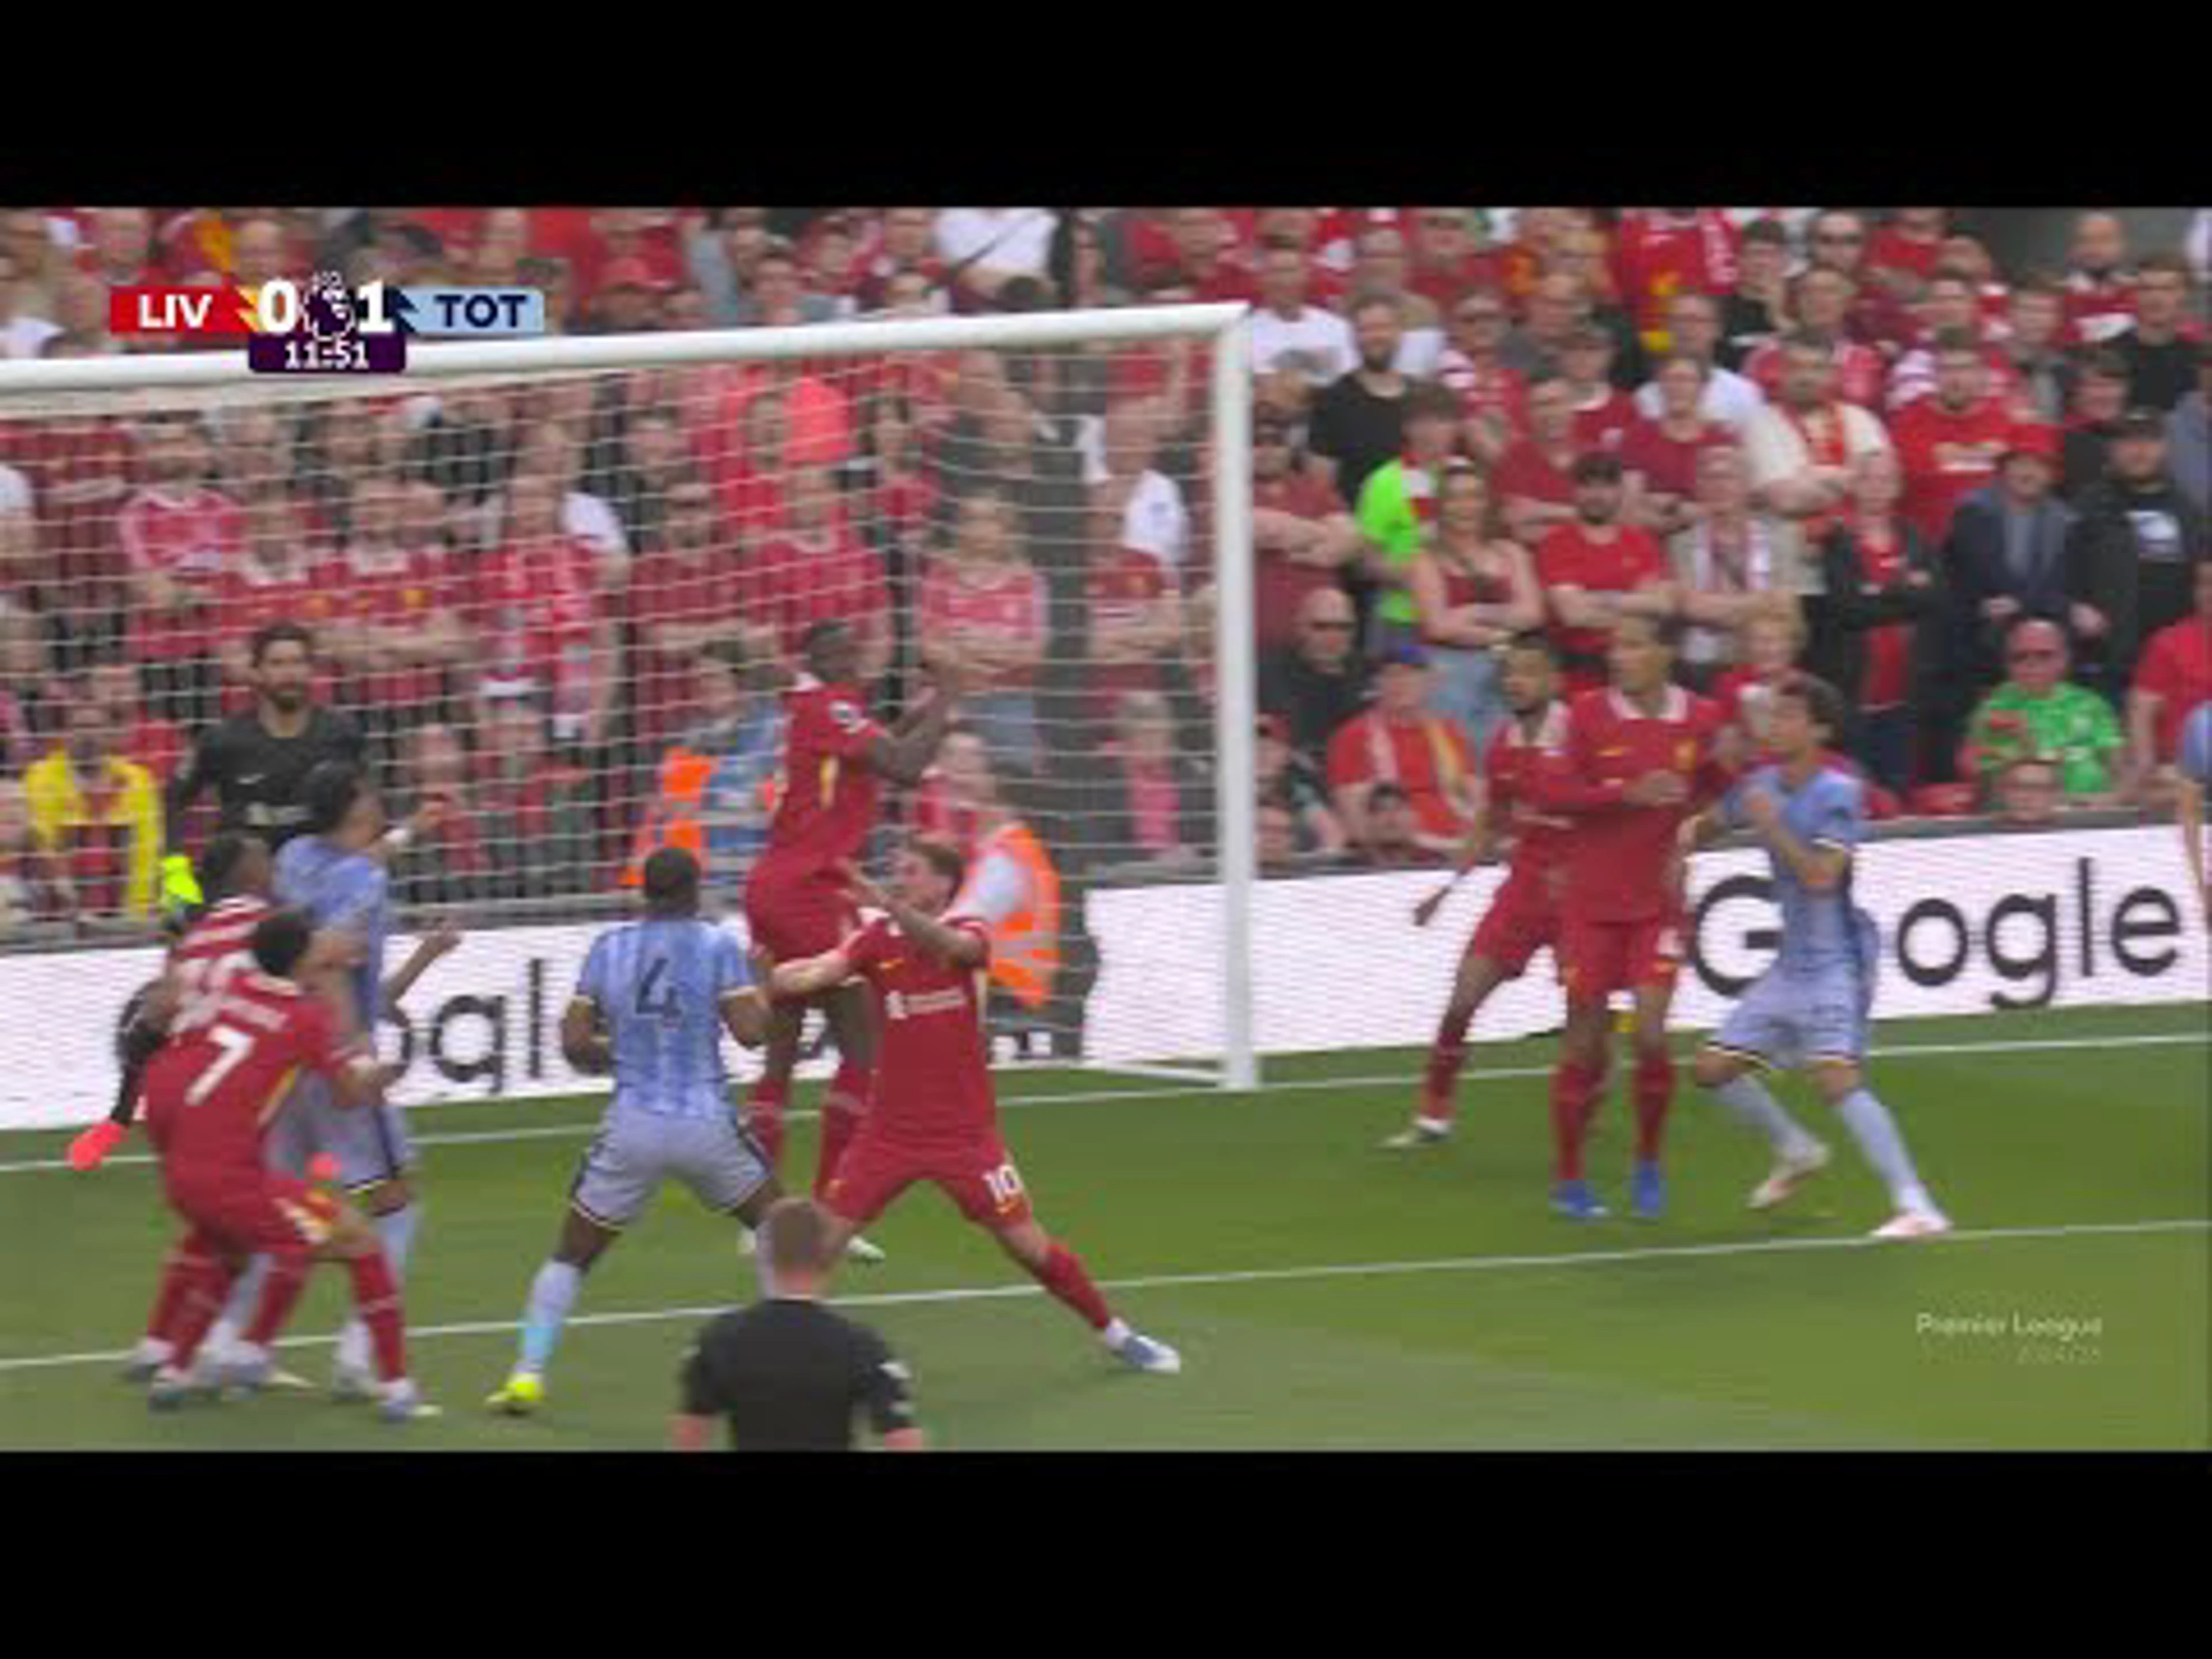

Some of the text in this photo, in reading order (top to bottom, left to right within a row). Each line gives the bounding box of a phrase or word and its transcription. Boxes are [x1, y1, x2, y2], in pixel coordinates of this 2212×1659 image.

[1692, 857, 2182, 1008] Gogle
[635, 957, 682, 1018] 4
[184, 1024, 256, 1107] 7
[983, 1164, 1023, 1203] 10
